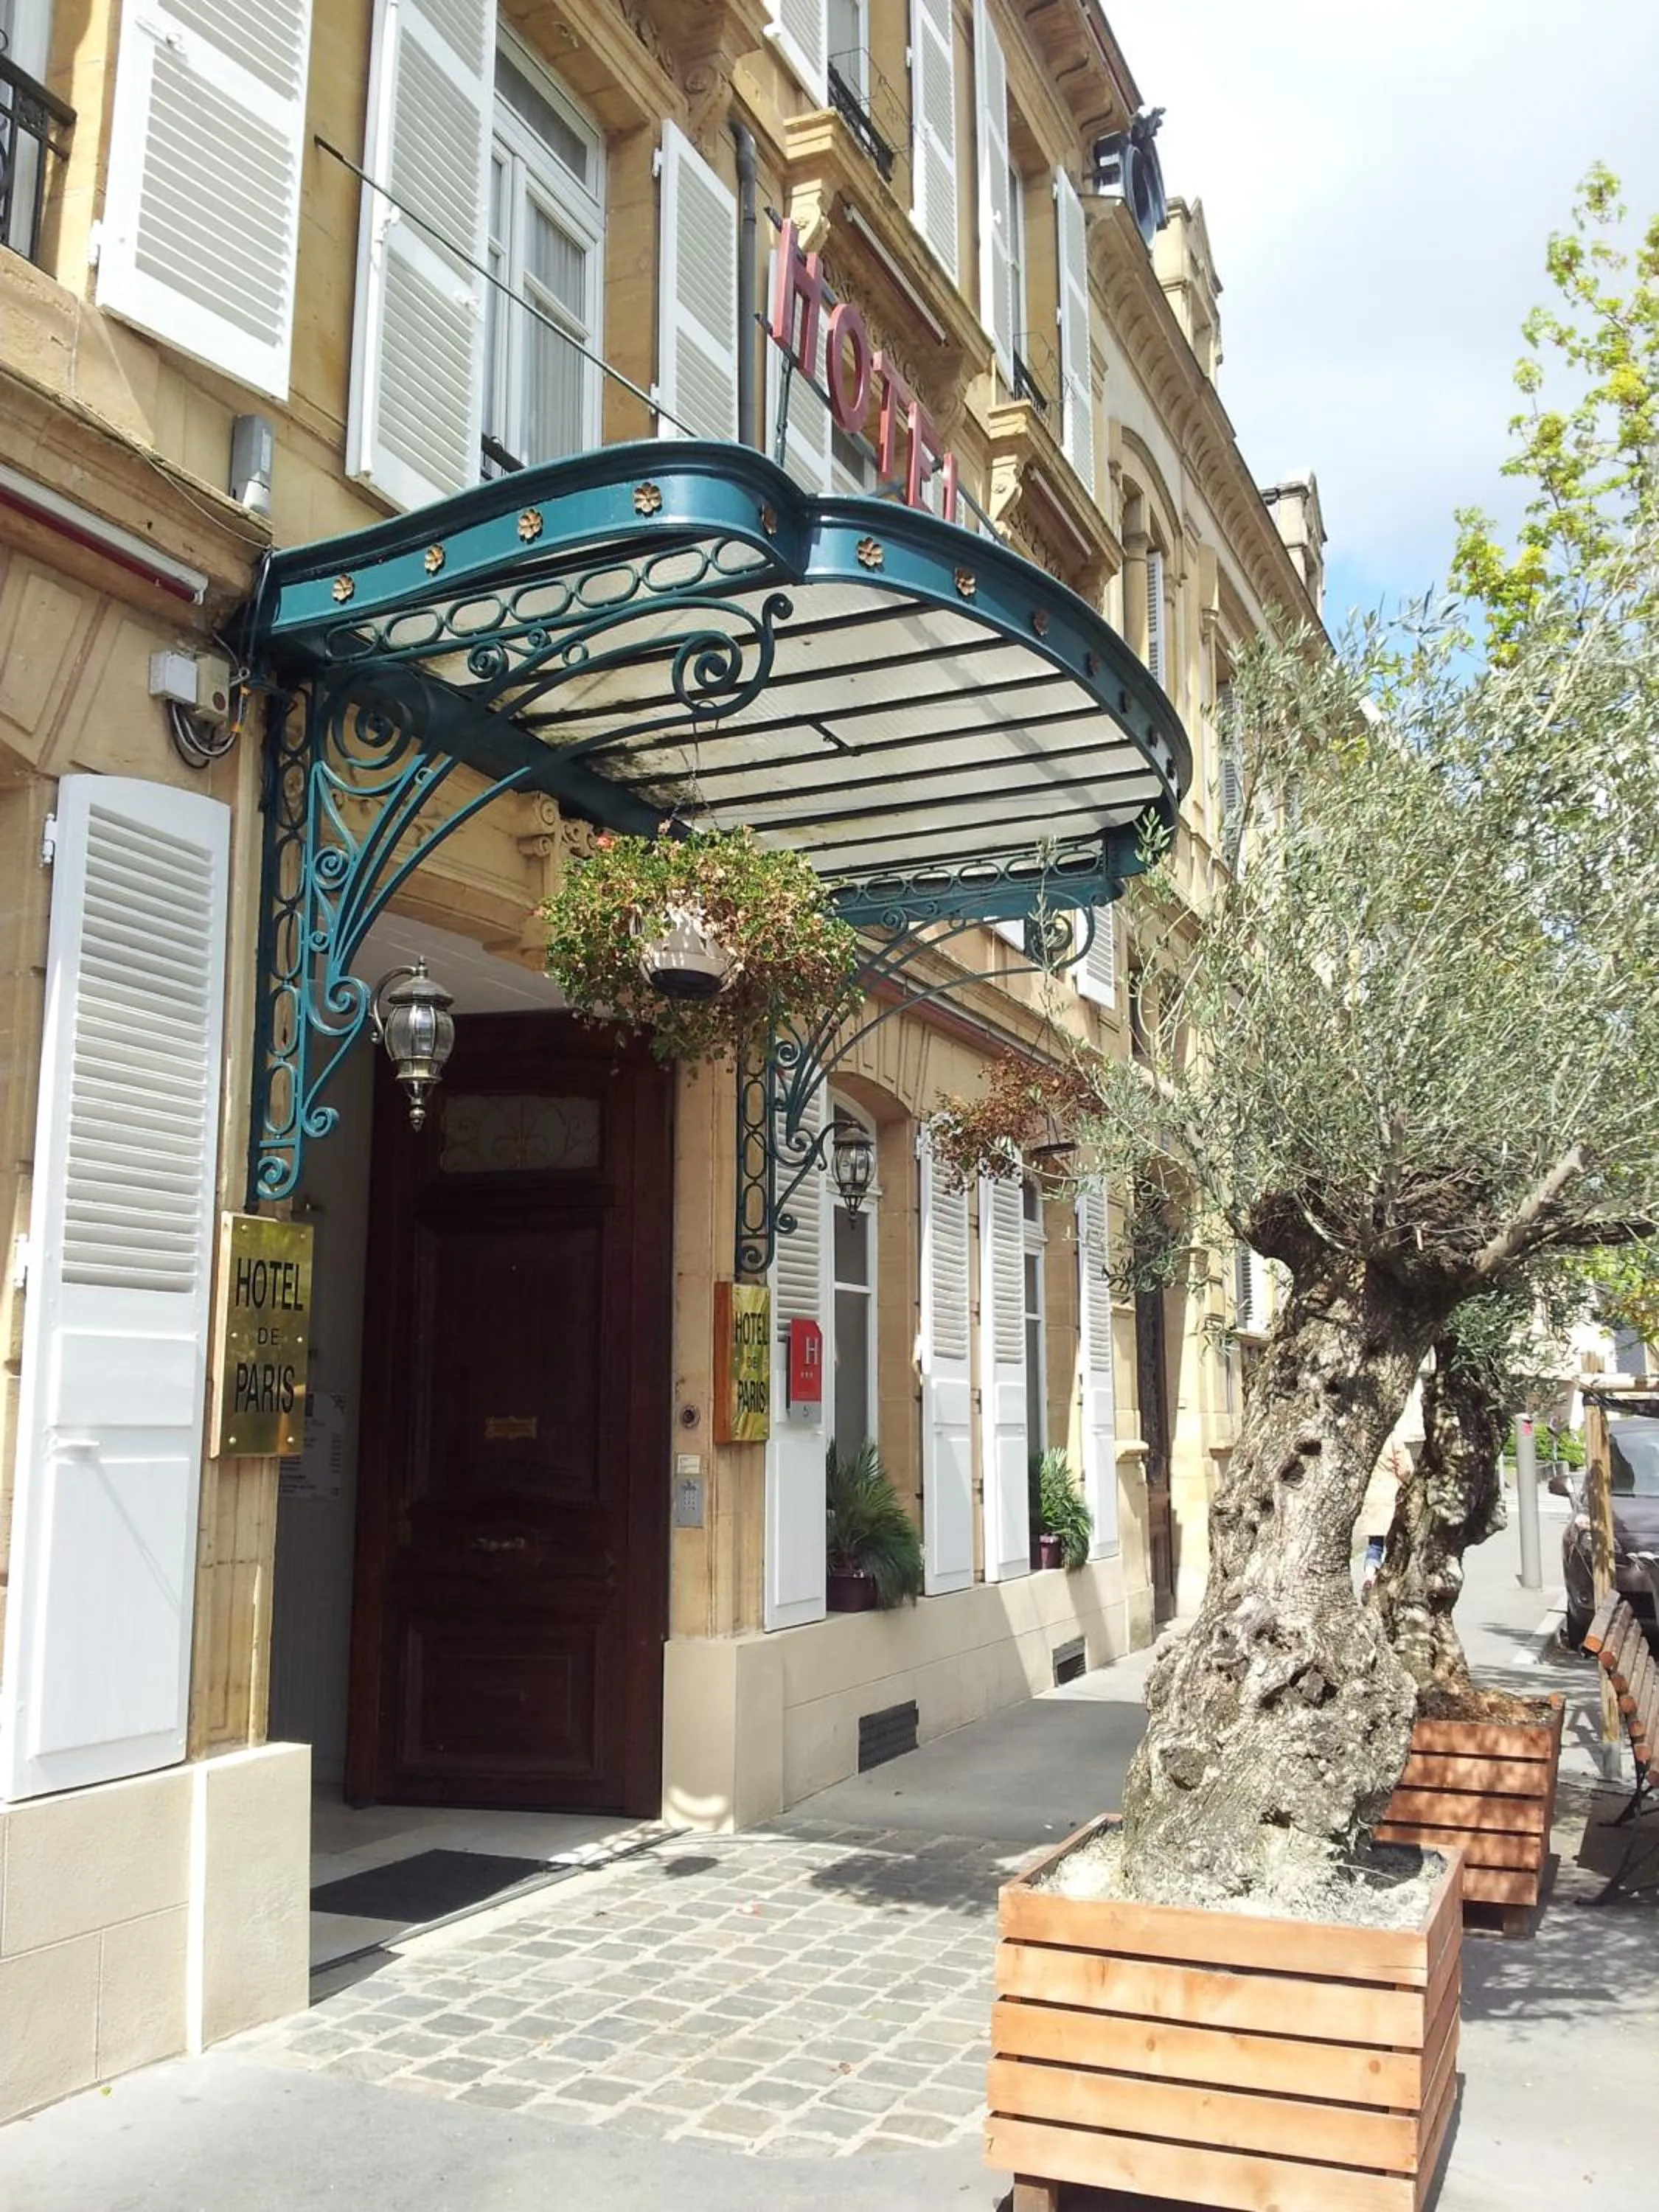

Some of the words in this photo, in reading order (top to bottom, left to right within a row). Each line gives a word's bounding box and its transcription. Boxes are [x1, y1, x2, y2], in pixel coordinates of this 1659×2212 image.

[235, 1256, 304, 1311] HOTEL
[257, 1327, 280, 1346] DE
[734, 1311, 769, 1346] HOTEL
[805, 1335, 818, 1366] H
[234, 1362, 296, 1414] PARIS
[737, 1380, 766, 1413] PARIS
